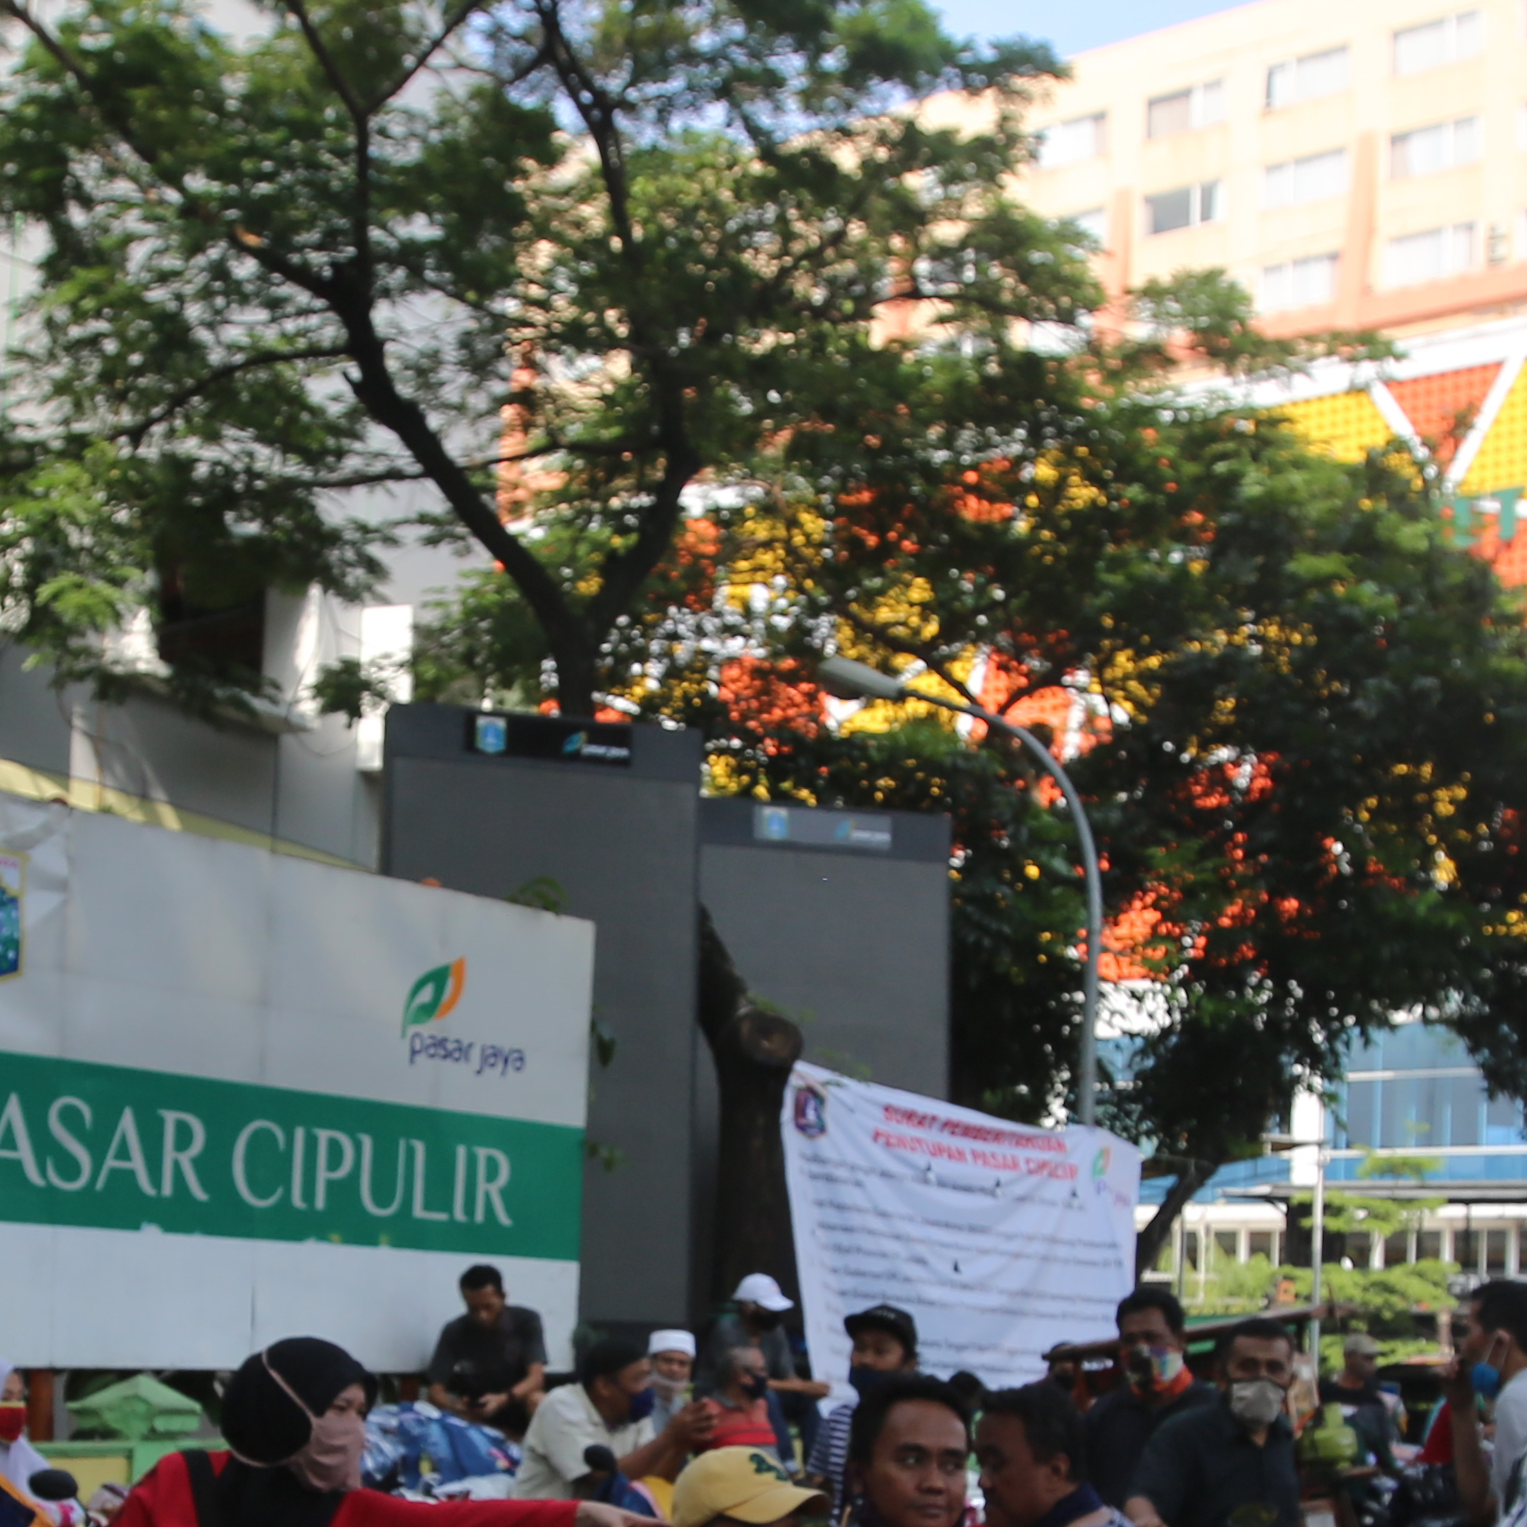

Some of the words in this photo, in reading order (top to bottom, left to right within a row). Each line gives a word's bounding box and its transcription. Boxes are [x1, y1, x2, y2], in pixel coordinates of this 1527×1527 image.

[409, 1031, 474, 1066] pasar
[474, 1044, 525, 1077] jaya
[232, 1119, 513, 1226] CIPULIR
